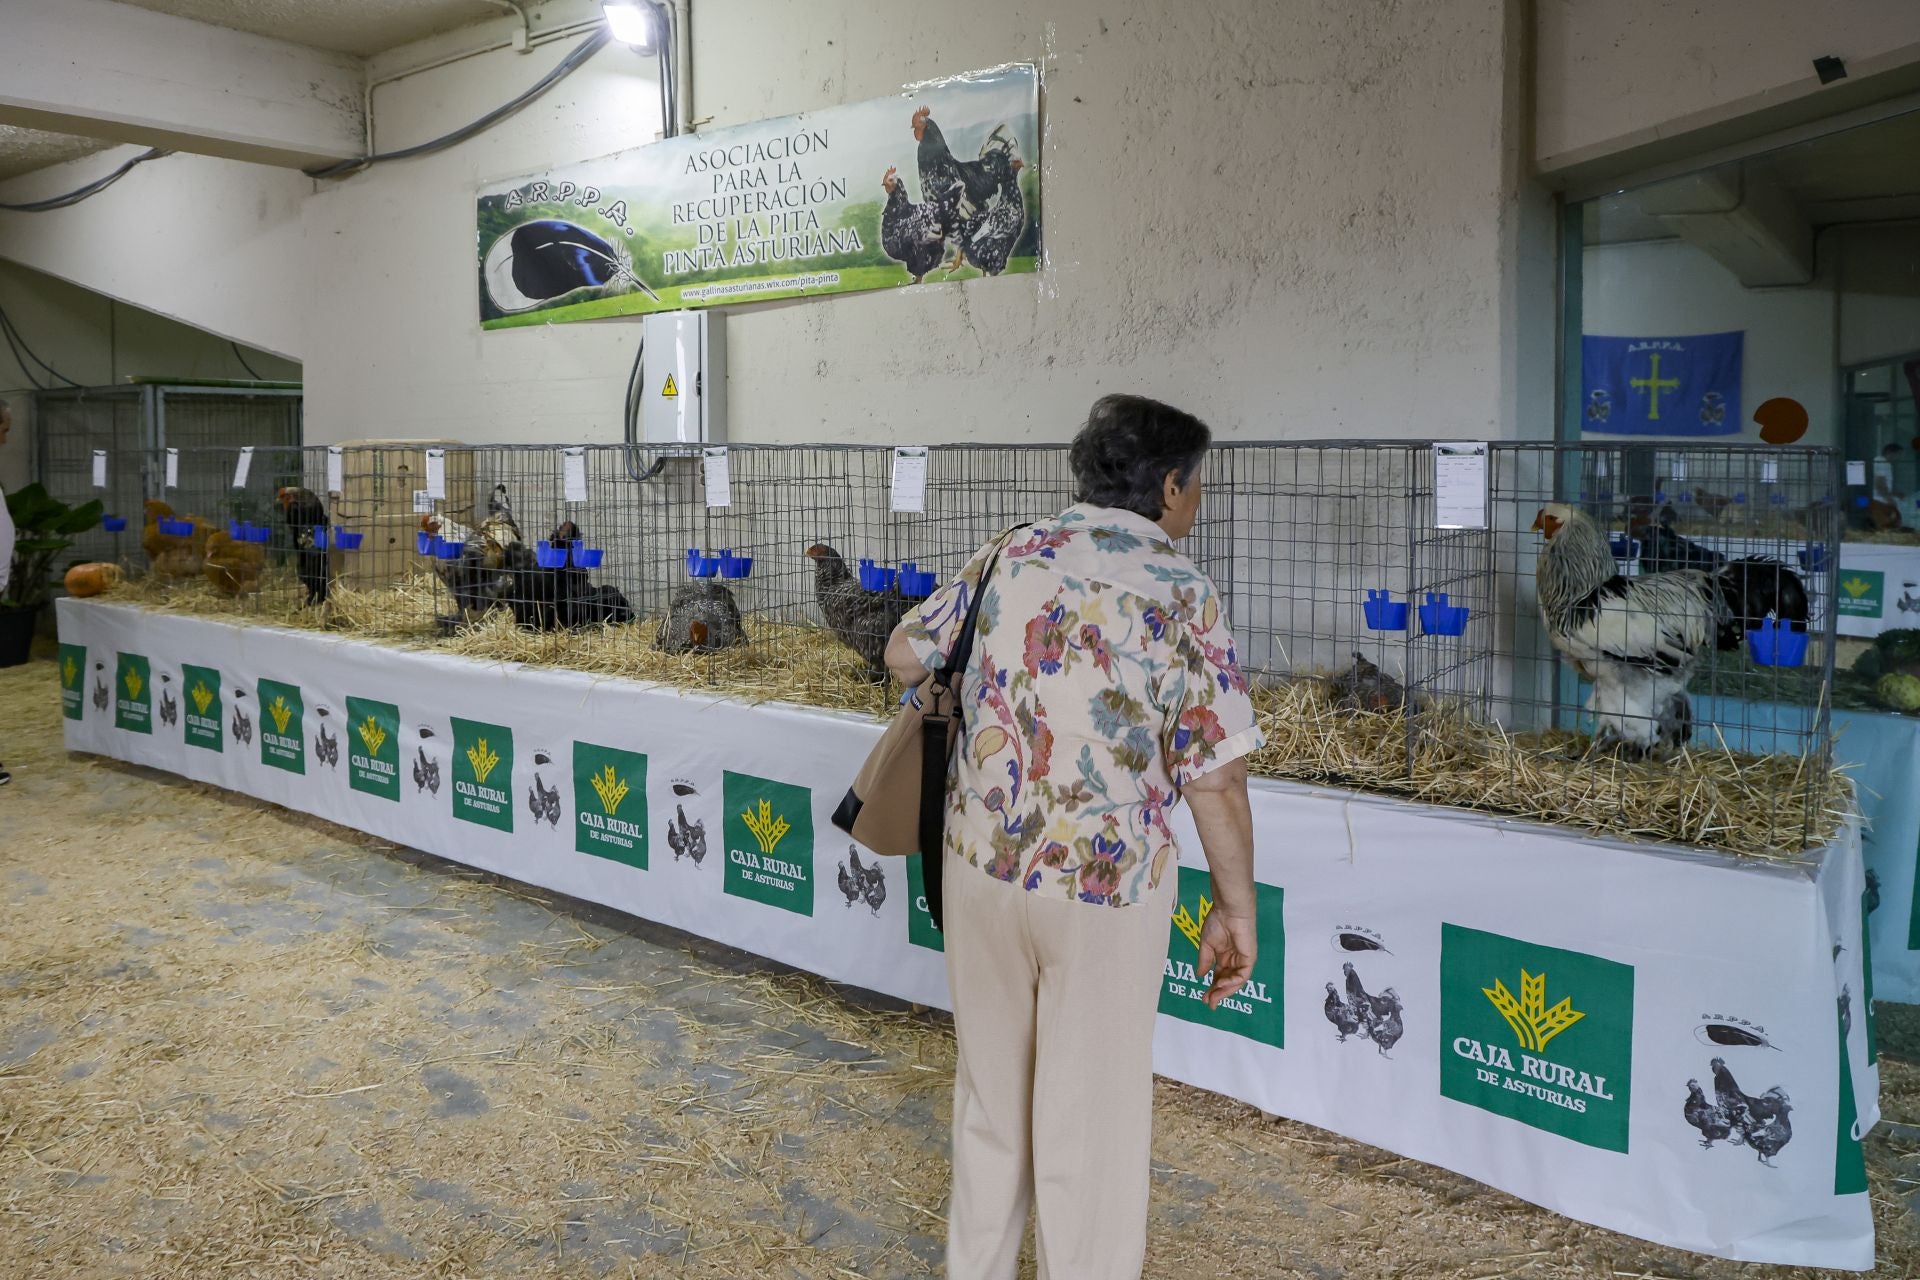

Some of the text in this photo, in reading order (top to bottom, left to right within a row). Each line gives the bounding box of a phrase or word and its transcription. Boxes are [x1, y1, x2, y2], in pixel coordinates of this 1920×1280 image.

[685, 128, 829, 175] ASOCIACIÓN
[713, 161, 803, 194] PARA LA
[673, 176, 847, 224] RECUPERACIÓN
[699, 209, 820, 245] DE LA PITA
[664, 228, 862, 273] PINTA ASTURIANA
[682, 273, 839, 298] www.gallinasasturianas.wix.com/pita-pinta
[351, 755, 396, 776] CAJA RURAL
[456, 781, 508, 804] CAJA RURAL
[464, 798, 473, 807] DE
[580, 812, 642, 839] CAJA RURAL
[590, 830, 633, 849] DE ASTURIAS
[730, 849, 807, 881] CAJA RURAL
[742, 869, 795, 892] DE ASTURIAS
[1163, 958, 1198, 984] AJA
[1169, 982, 1253, 1015] DE ASRIAS
[1453, 1037, 1614, 1101] CAJA RURAL
[1476, 1068, 1587, 1114] DE ASTURIAS
